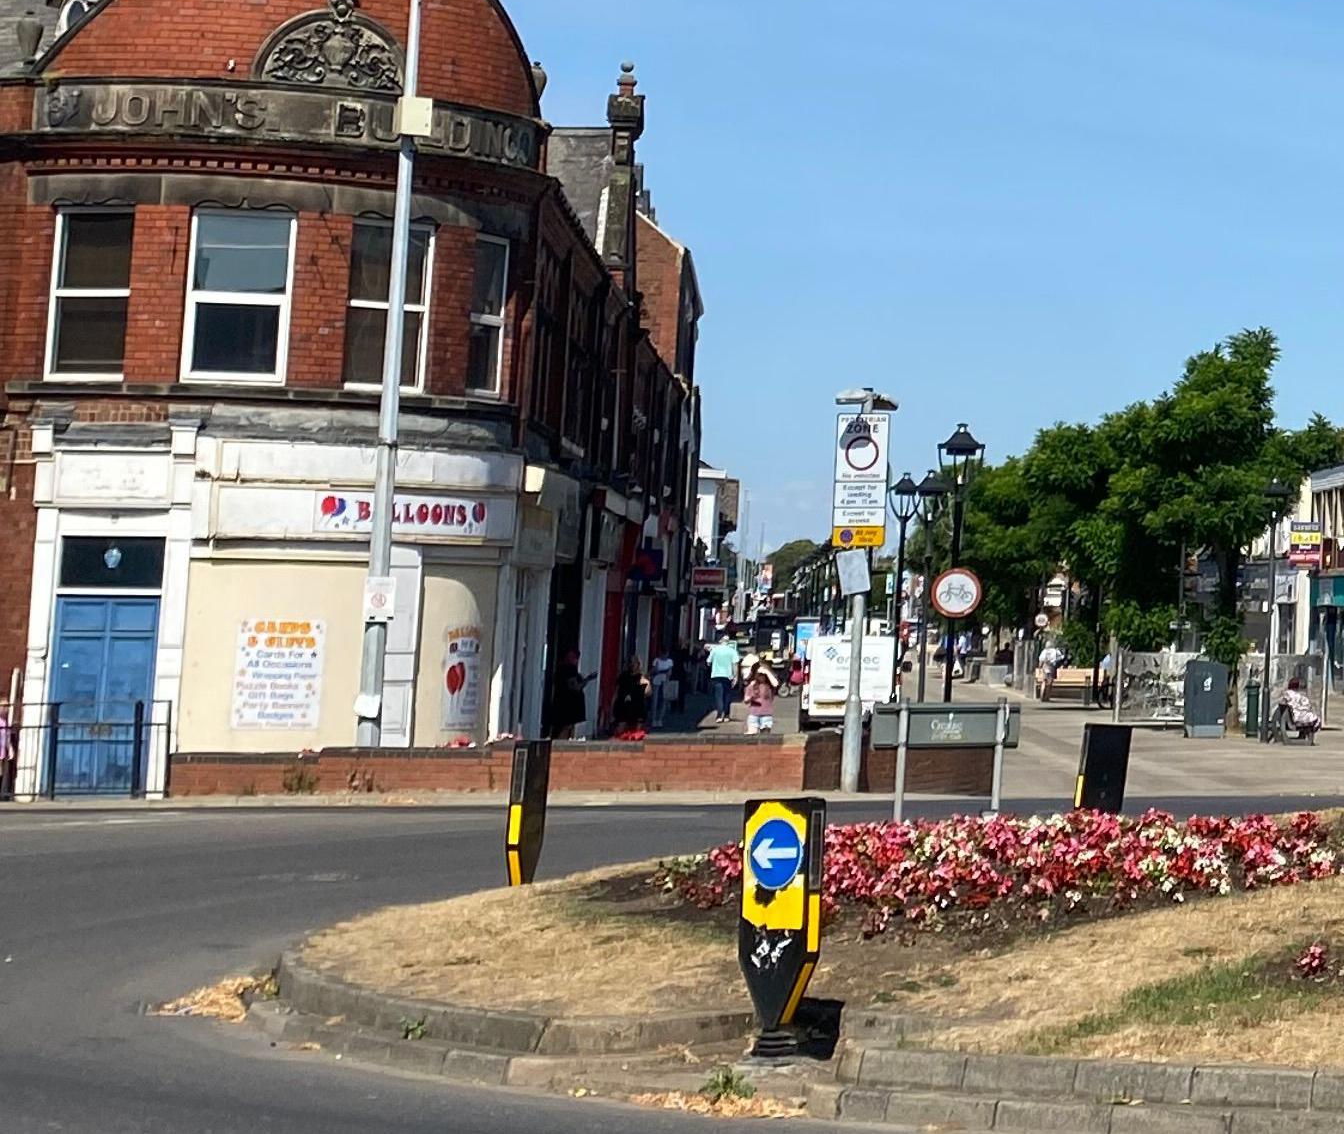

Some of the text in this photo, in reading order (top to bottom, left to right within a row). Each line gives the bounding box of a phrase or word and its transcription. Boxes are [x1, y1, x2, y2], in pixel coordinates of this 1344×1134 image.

[334, 101, 533, 165] BULDINGS
[846, 424, 879, 433] ZONE
[356, 500, 467, 527] BLLOONS
